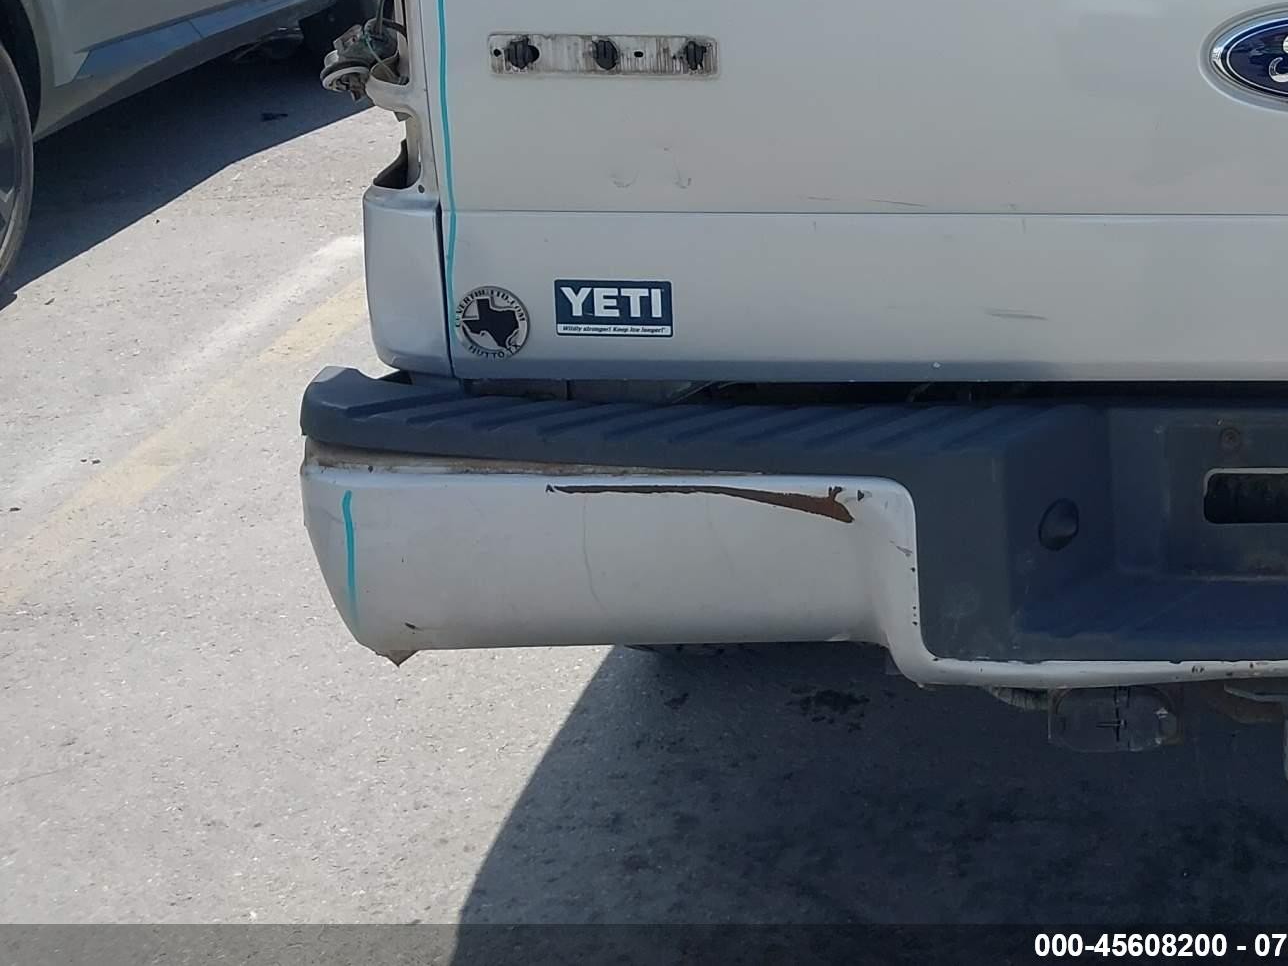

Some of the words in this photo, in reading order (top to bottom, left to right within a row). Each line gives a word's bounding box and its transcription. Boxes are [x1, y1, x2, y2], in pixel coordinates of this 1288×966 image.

[559, 287, 662, 318] YETI
[468, 345, 505, 359] HUTTO
[506, 343, 522, 355] TX
